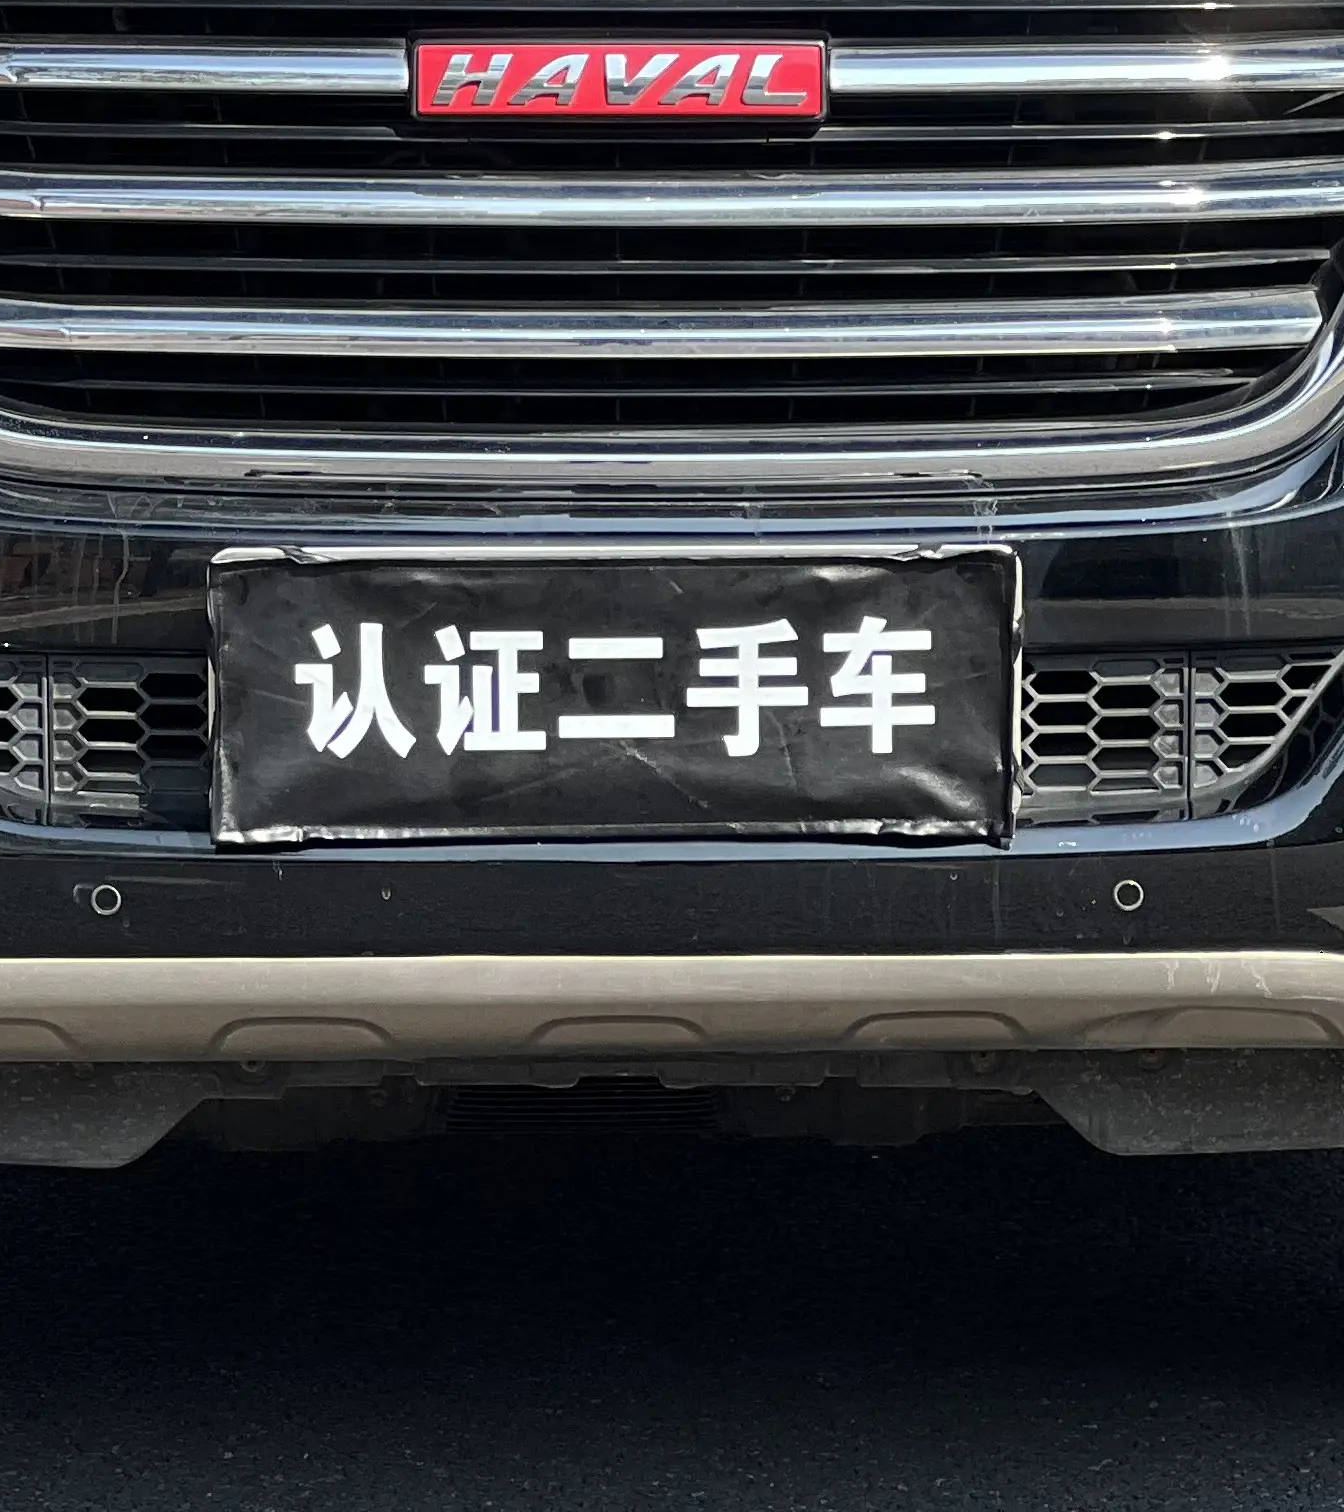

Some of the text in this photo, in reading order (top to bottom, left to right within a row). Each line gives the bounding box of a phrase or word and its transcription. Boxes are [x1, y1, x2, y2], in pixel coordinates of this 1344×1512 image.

[431, 53, 808, 106] HAVAL
[293, 615, 936, 759] 认证二手车
